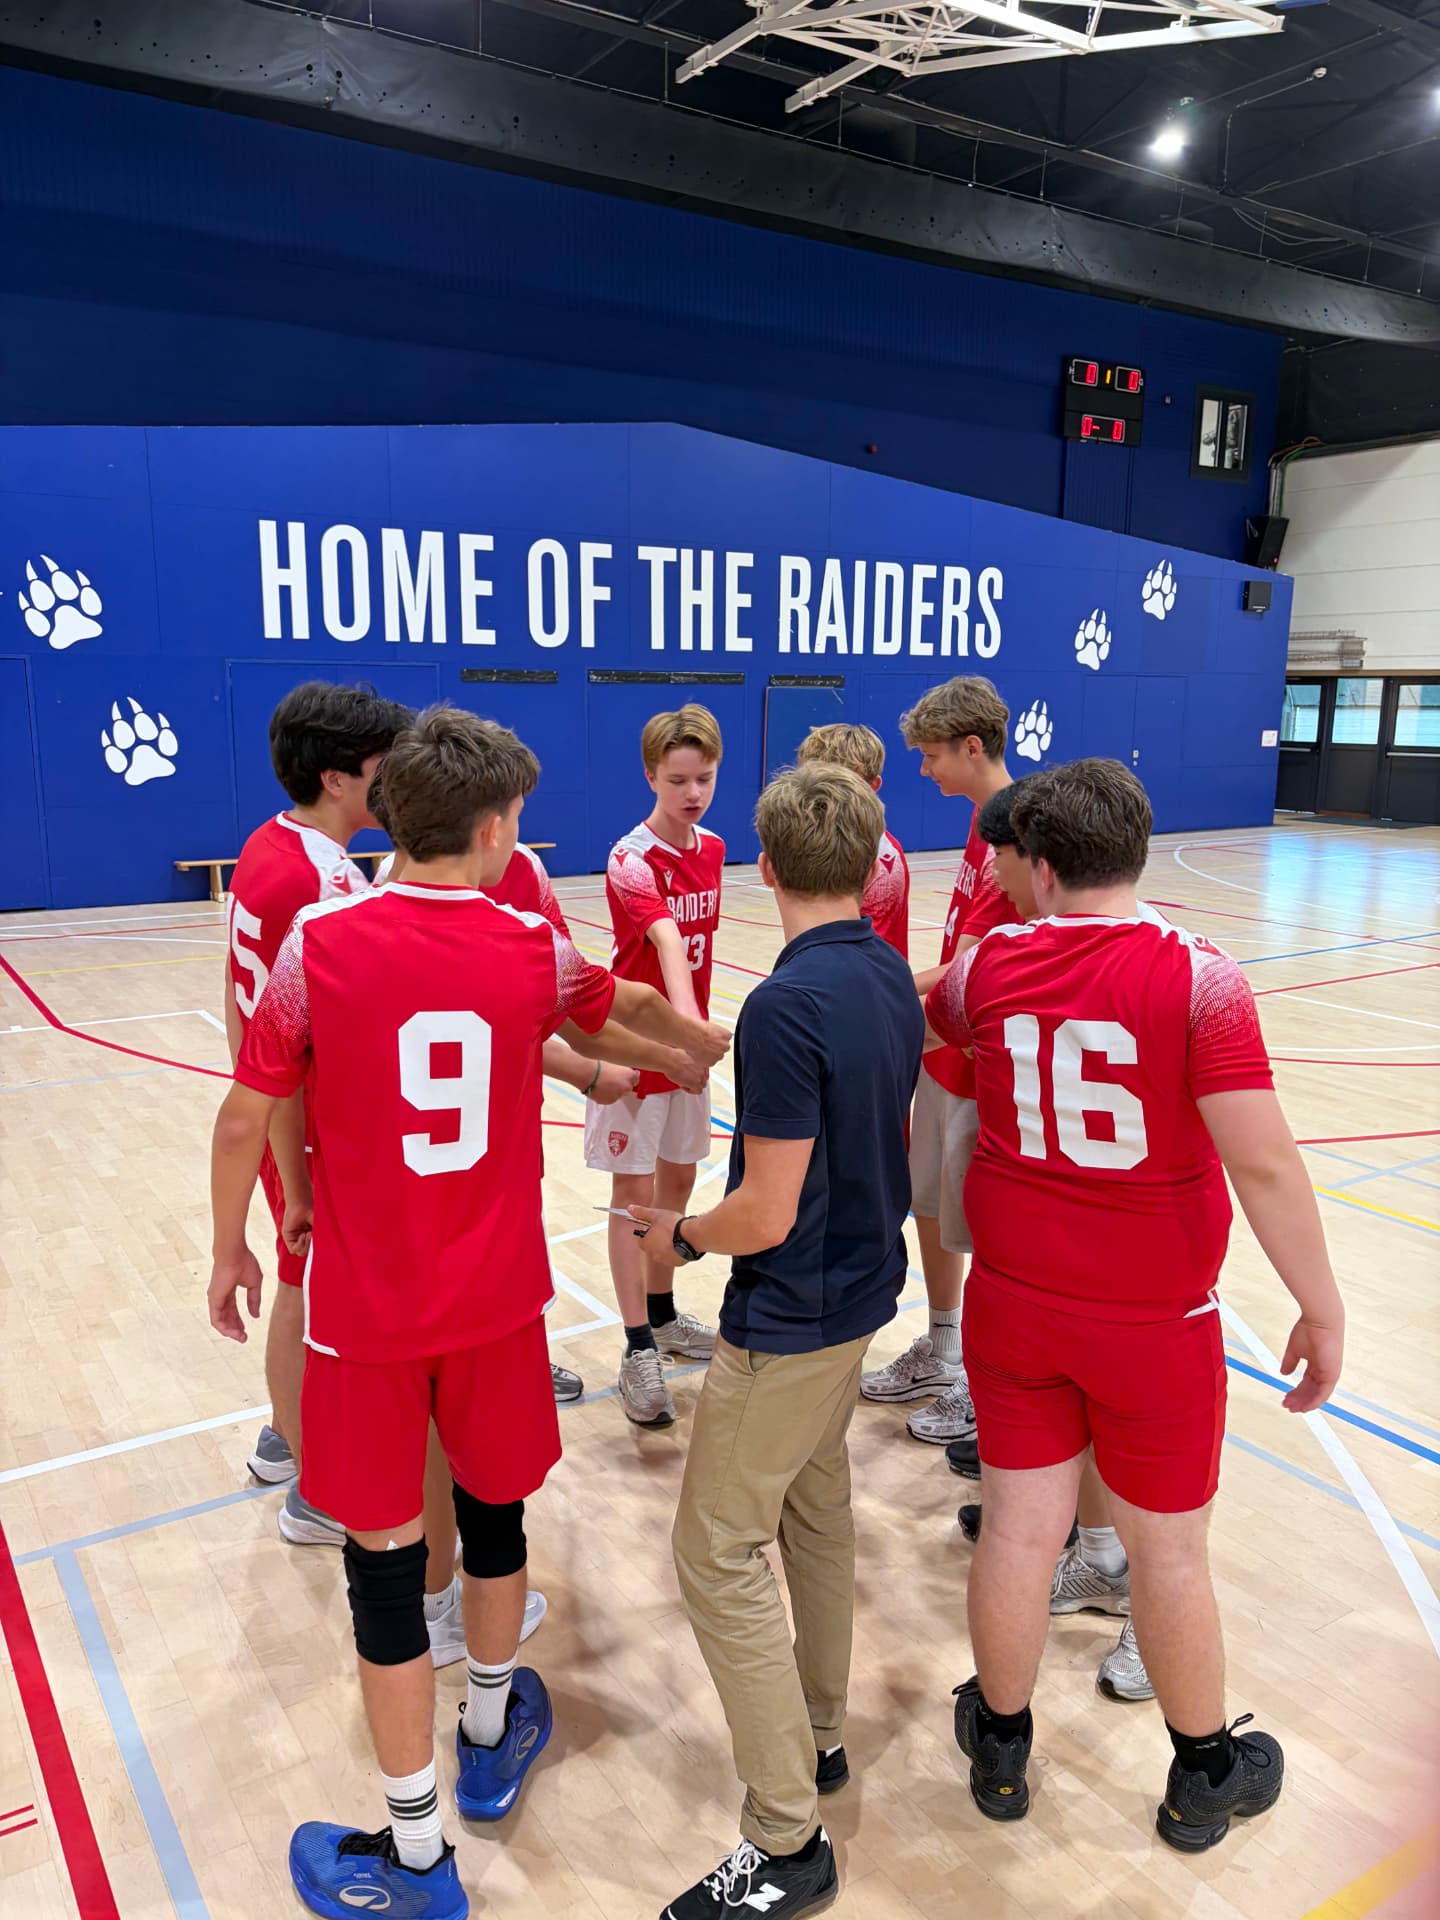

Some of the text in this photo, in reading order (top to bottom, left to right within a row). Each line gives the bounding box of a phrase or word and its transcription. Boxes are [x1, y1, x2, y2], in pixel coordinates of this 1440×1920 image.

[1086, 364, 1097, 384] 0
[1128, 371, 1139, 390] 0
[258, 519, 1004, 659] HOME OF THE RAIDERS
[397, 1010, 492, 1177] 9
[1003, 1013, 1149, 1170] 16
